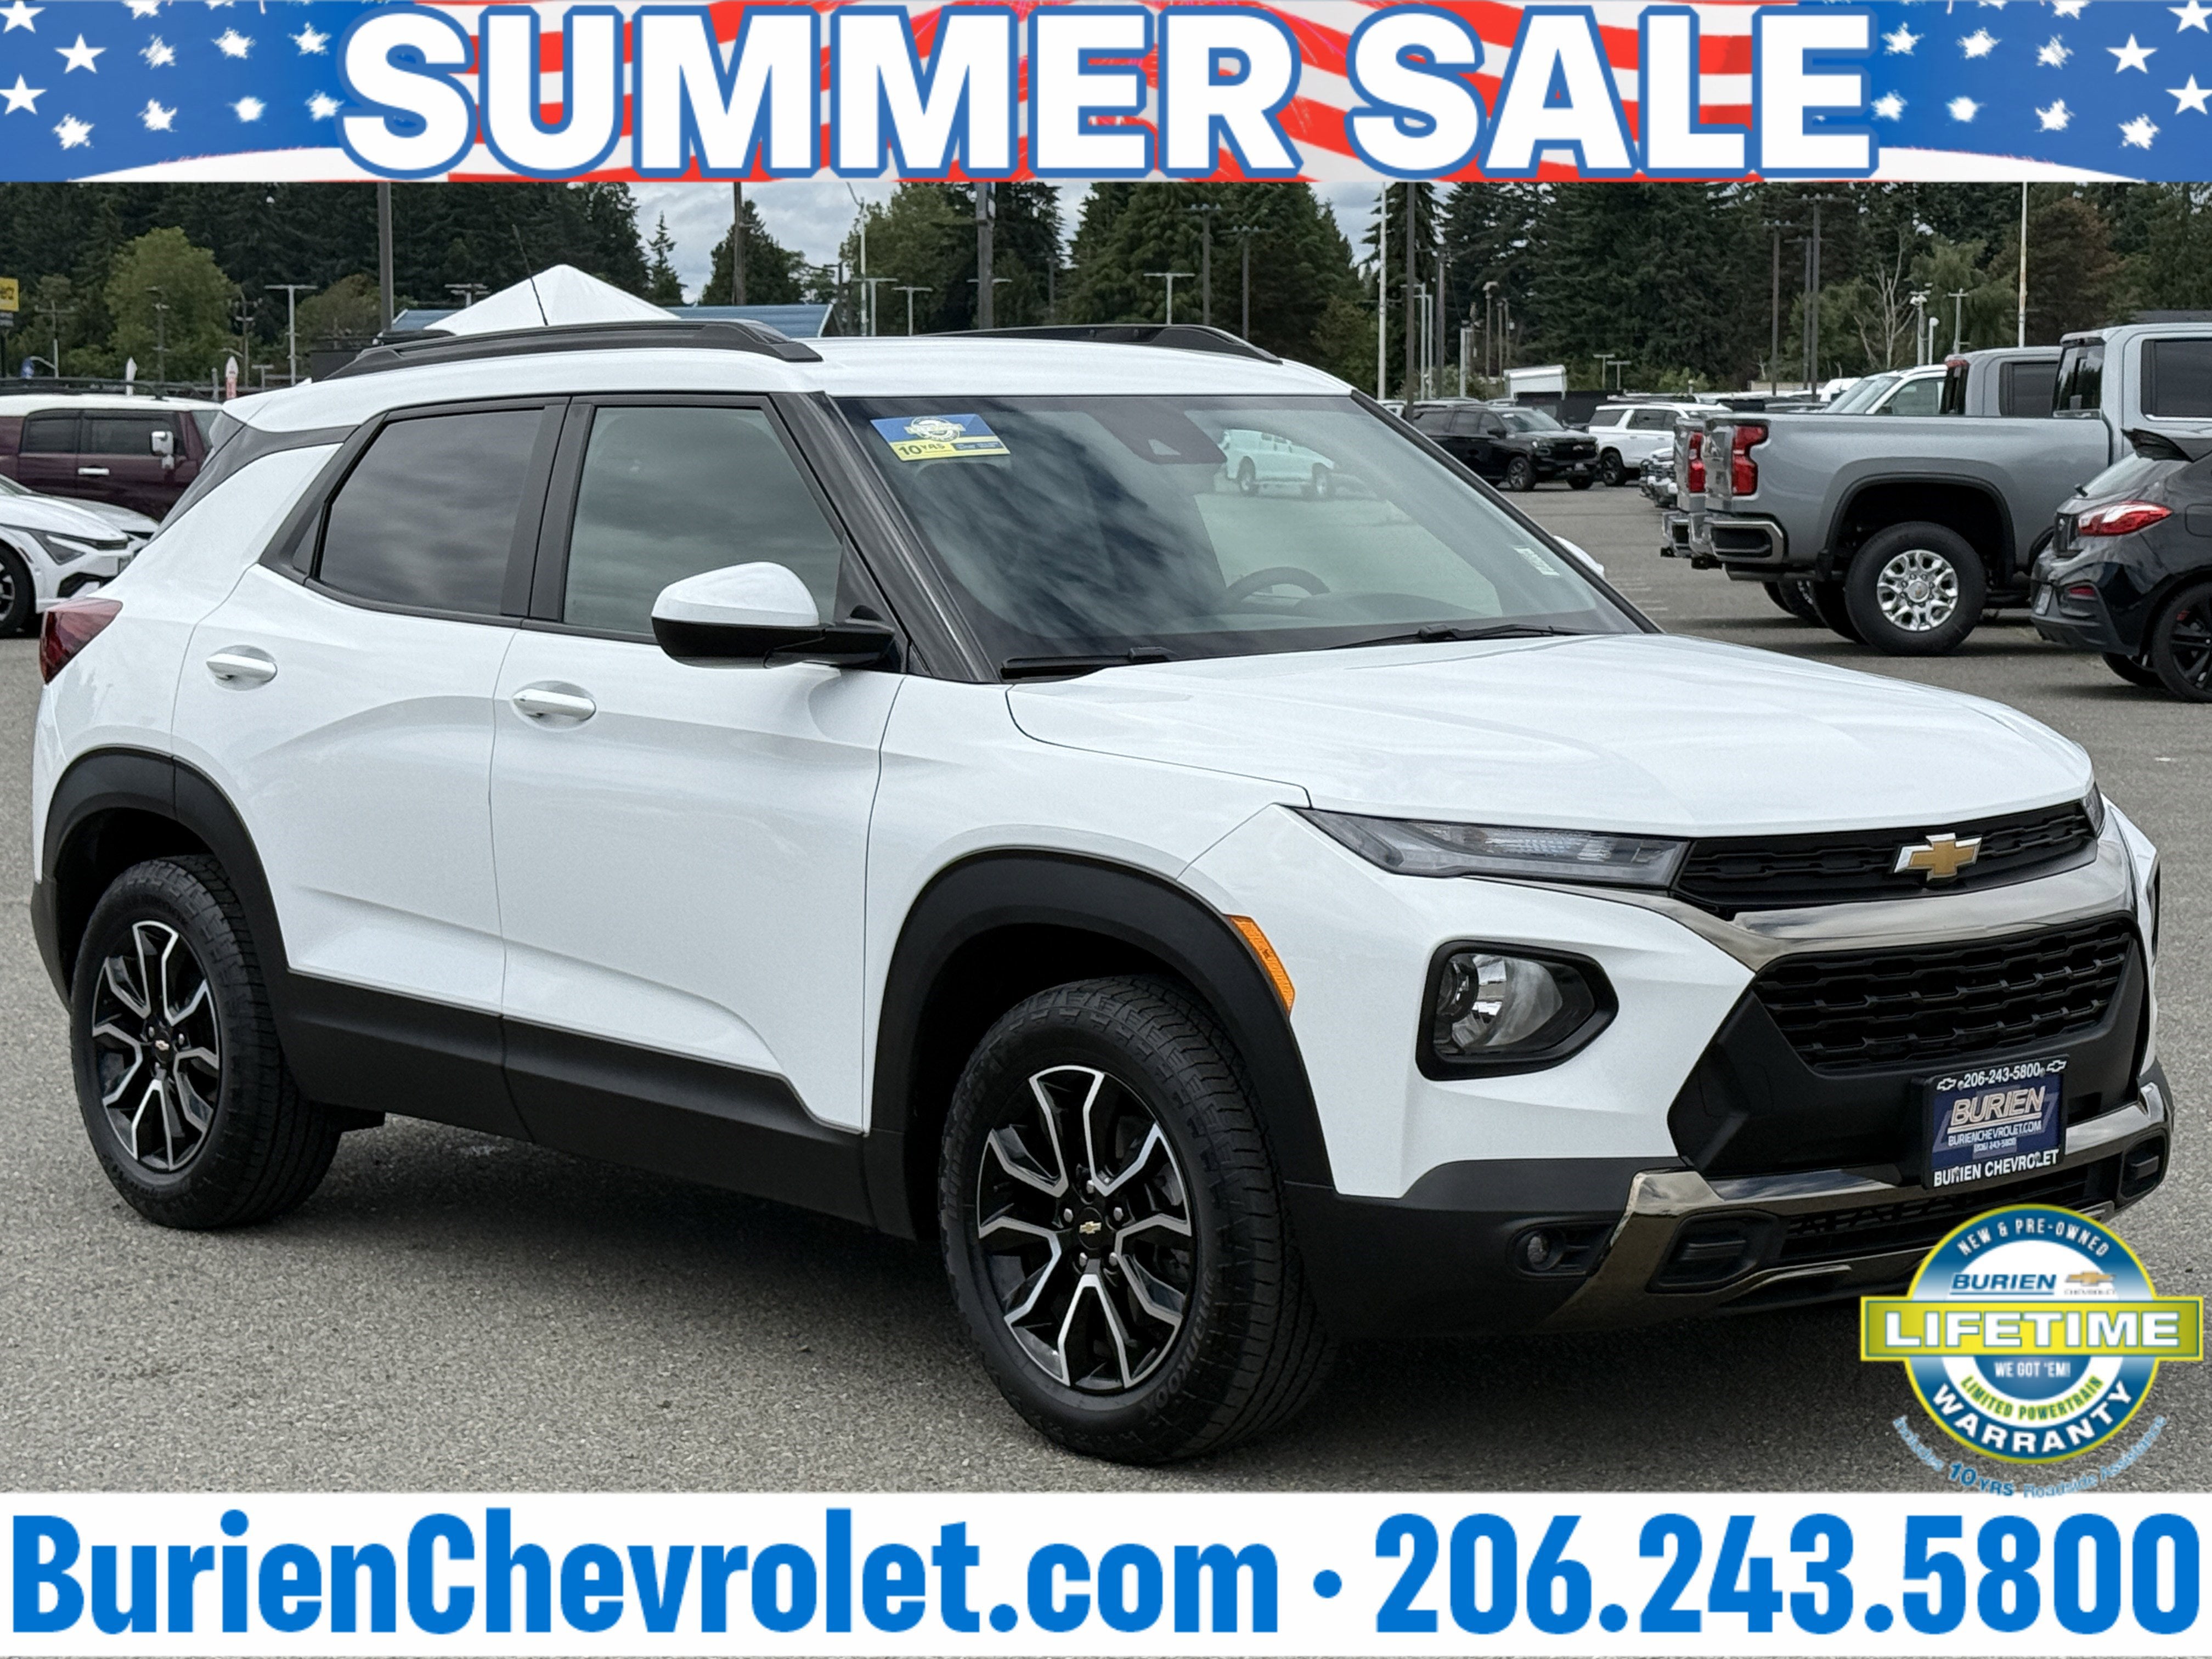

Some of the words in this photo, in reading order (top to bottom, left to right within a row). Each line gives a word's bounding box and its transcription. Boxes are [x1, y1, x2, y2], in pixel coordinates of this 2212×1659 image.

[899, 445, 922, 456] 10
[1962, 1062, 2040, 1088] 206-243-5800
[1950, 1086, 2046, 1126] BURIEN
[1948, 1120, 2042, 1147] BURIENCHEVROLET.COM
[1933, 1163, 1982, 1187] BURIEN
[1984, 1148, 2059, 1177] CHEVROLET
